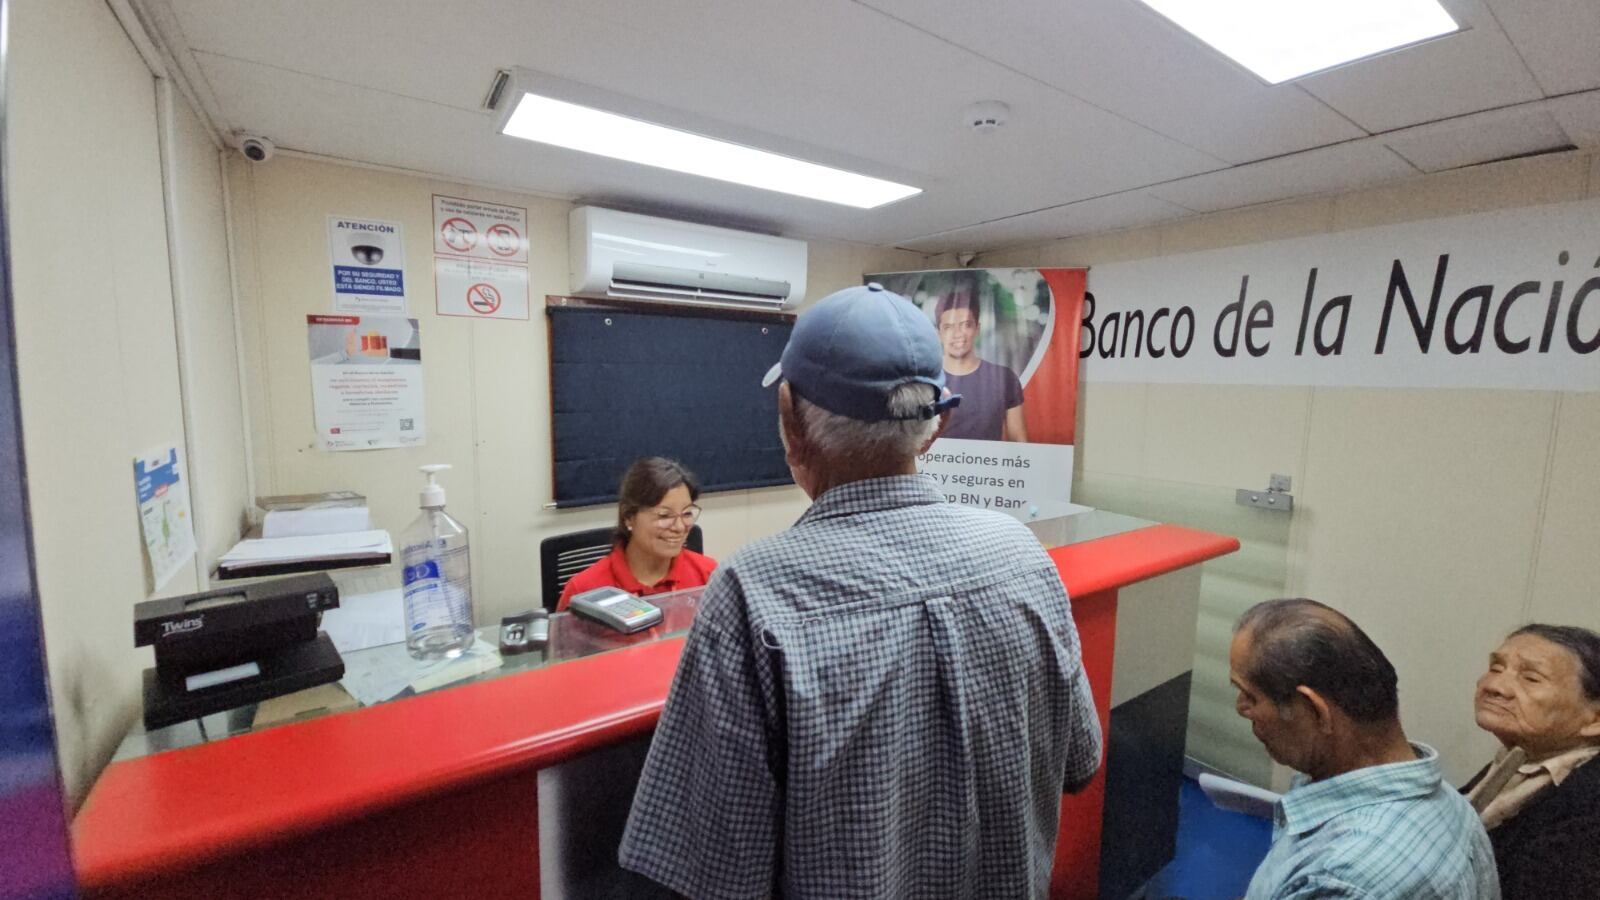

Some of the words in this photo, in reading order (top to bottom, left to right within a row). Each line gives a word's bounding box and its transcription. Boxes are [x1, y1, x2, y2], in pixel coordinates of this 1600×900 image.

[337, 221, 394, 233] ATENCIÓN
[361, 271, 394, 279] SEGURIDAD
[1079, 291, 1195, 359] Banco
[1213, 275, 1274, 358] de
[1294, 267, 1352, 356] la
[918, 452, 998, 466] operaciones
[1002, 455, 1031, 468] más
[941, 474, 949, 485] y
[952, 475, 1004, 489] seguras
[1008, 477, 1025, 488] en
[961, 493, 980, 505] BN
[984, 497, 992, 509] y
[161, 617, 203, 633] Twins
